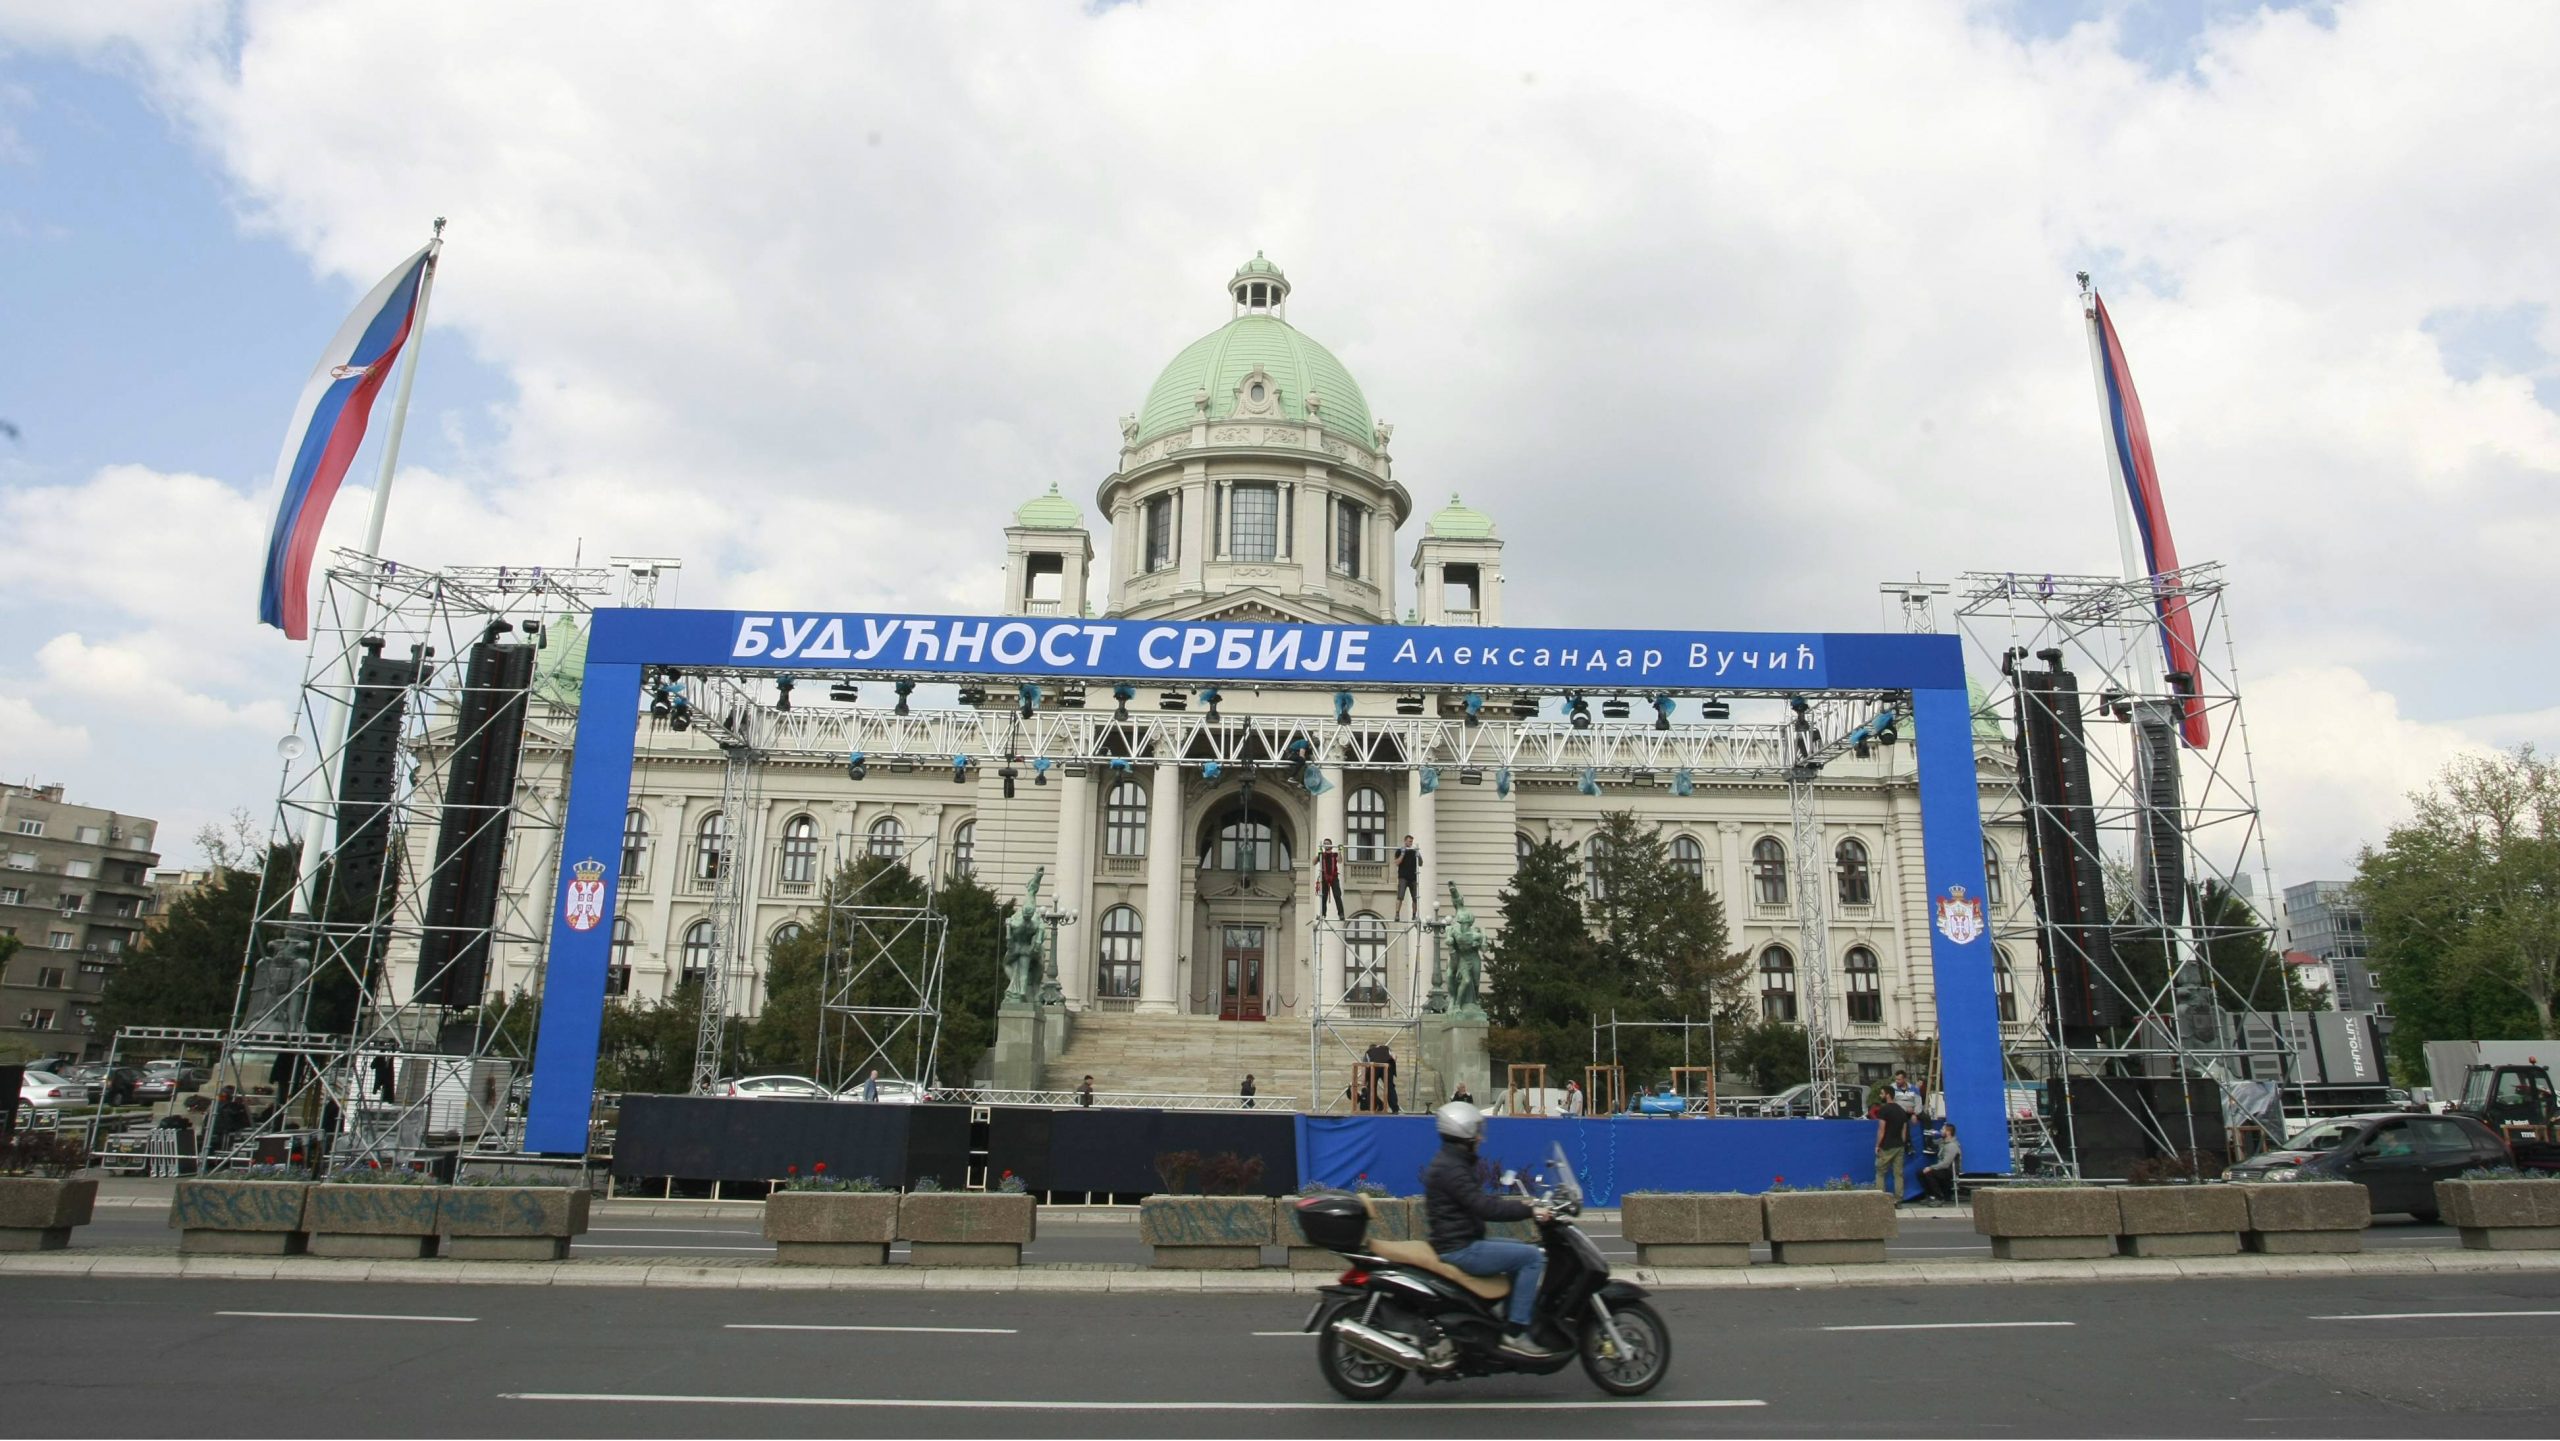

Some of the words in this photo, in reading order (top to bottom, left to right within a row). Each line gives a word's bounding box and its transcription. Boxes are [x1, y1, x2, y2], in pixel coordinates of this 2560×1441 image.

[732, 616, 1118, 668] БУДУЋНОСТ
[1138, 626, 1370, 673] СРБИЈЕ
[1392, 638, 1662, 675] Александар
[1688, 643, 1815, 676] Вучић
[2343, 1016, 2365, 1078] TEHNOLINK
